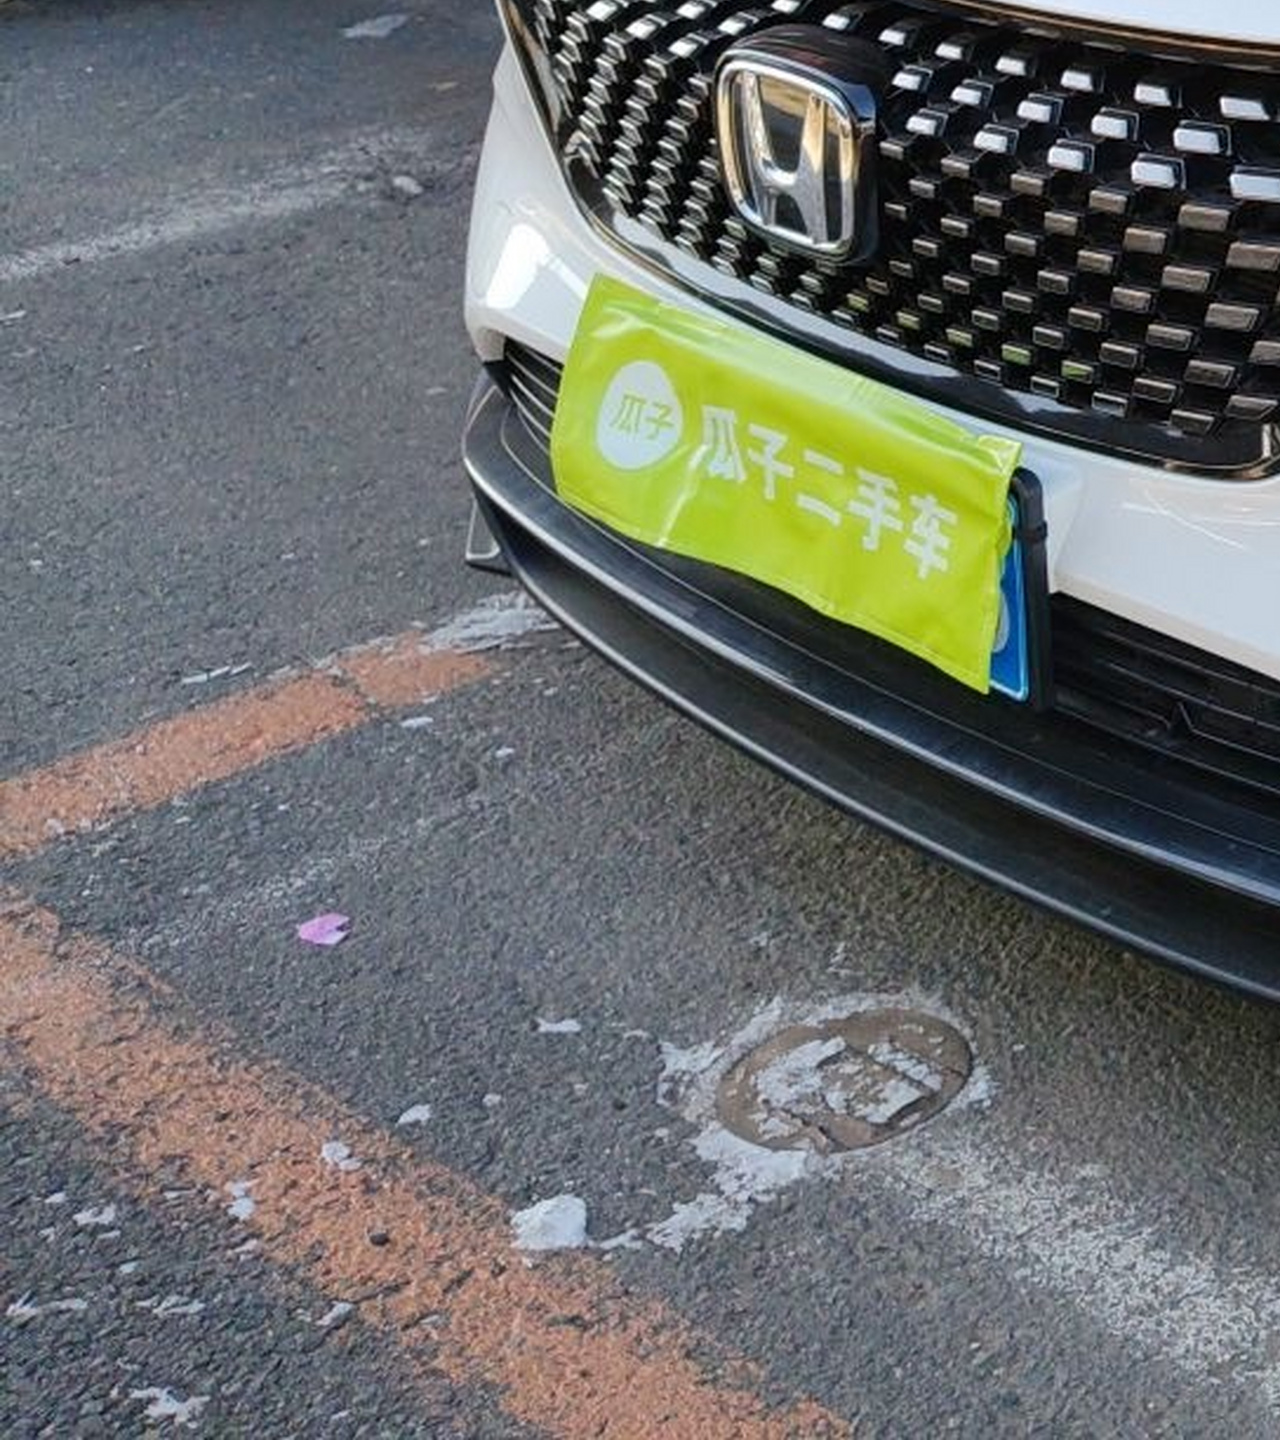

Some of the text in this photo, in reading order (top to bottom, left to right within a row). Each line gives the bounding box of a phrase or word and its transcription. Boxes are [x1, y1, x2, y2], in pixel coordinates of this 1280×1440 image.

[608, 392, 675, 441] 瓜子
[702, 404, 957, 580] 瓜子二手车
